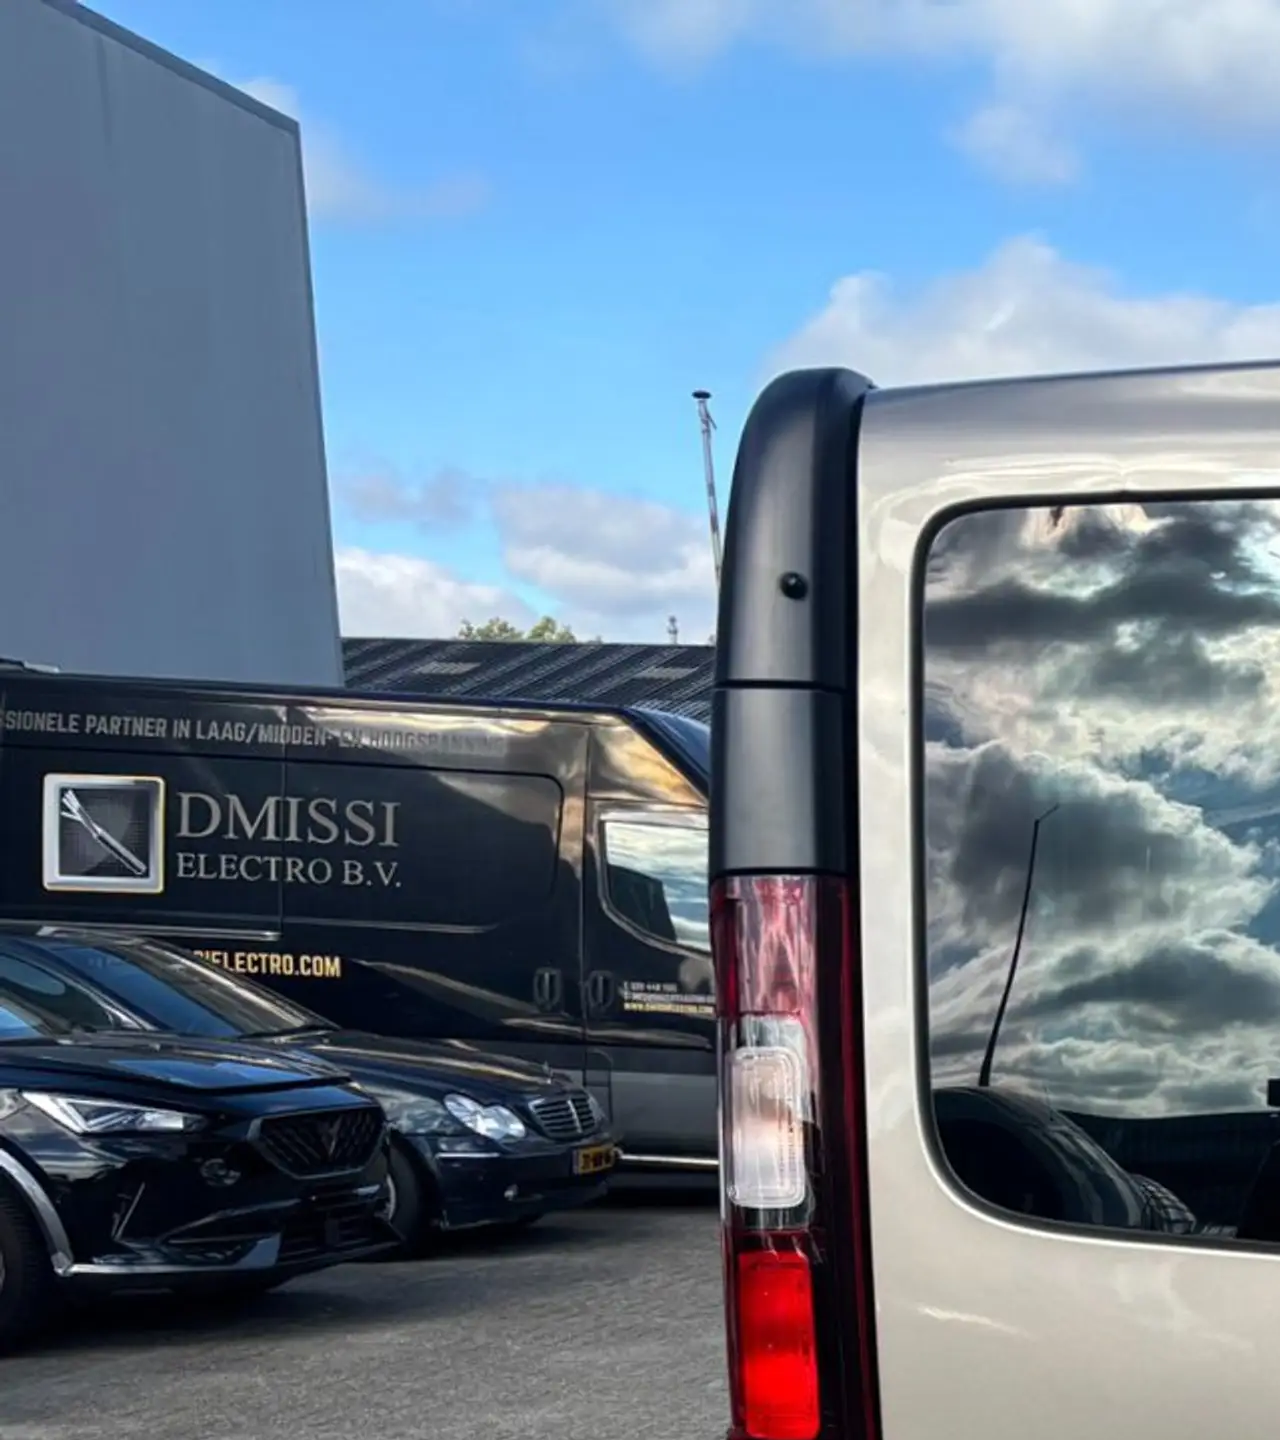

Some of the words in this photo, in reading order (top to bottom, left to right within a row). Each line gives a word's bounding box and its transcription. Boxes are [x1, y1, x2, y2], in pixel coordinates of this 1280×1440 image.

[85, 714, 166, 738] PARTNER
[173, 719, 190, 739] IN
[176, 792, 401, 847] DMISSI
[176, 852, 332, 884] ELECTRO
[342, 860, 401, 888] B.V.
